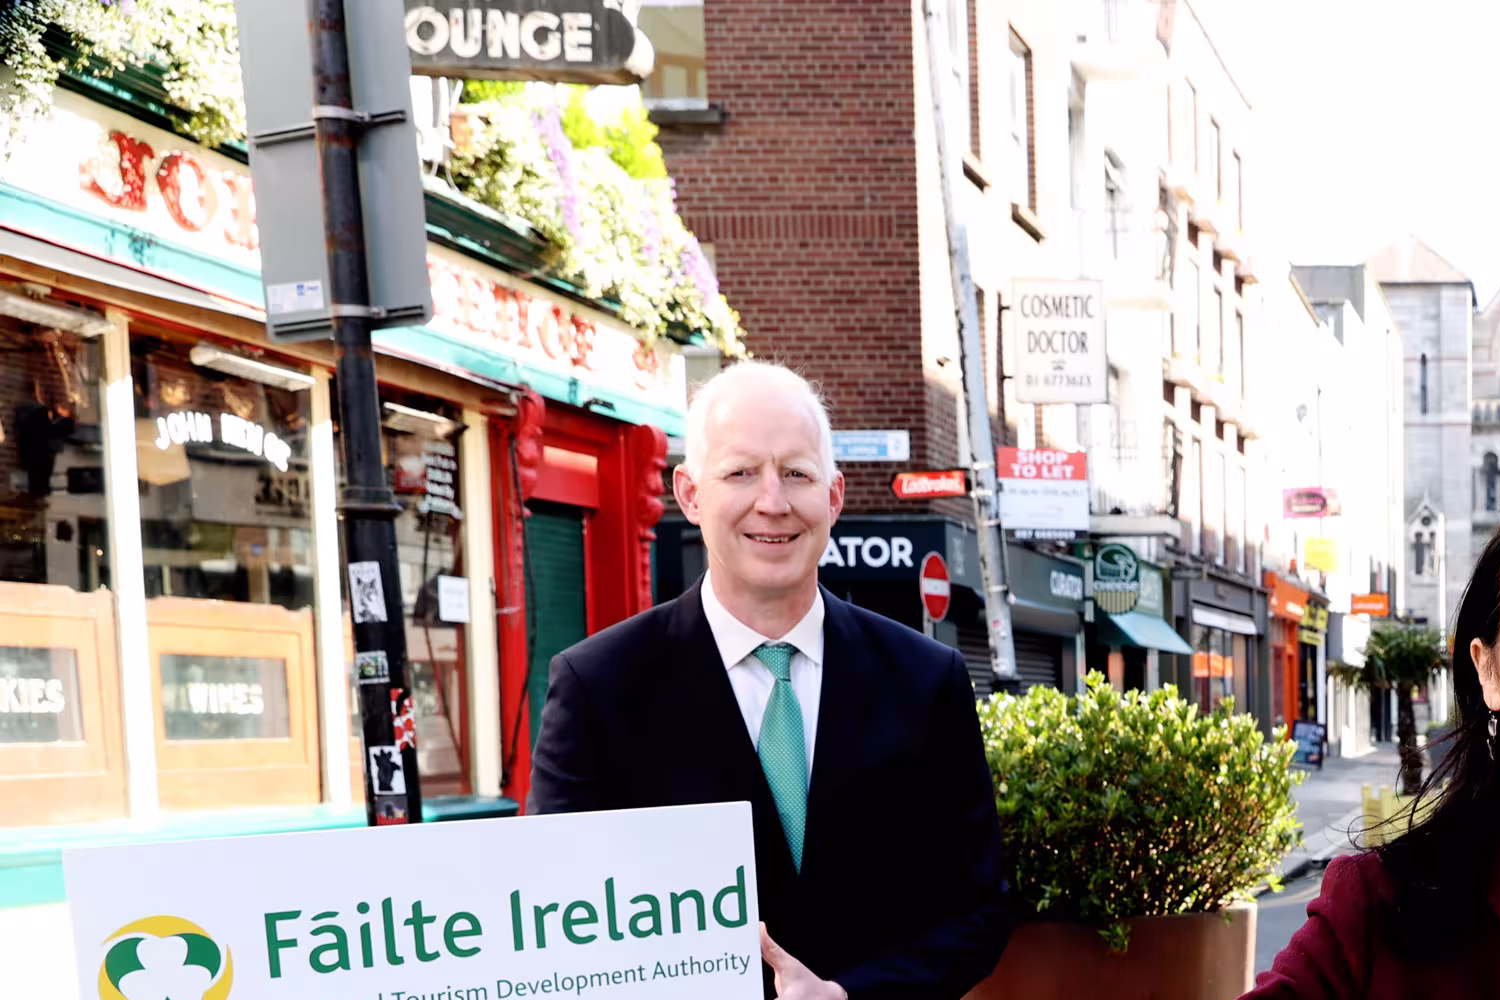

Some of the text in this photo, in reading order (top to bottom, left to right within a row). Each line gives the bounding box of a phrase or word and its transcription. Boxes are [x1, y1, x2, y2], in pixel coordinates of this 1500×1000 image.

[403, 5, 594, 63] OUNGE
[1020, 294, 1095, 319] COSMETIC
[1027, 330, 1089, 354] DOCTOR
[156, 411, 213, 450] JOHN
[1010, 464, 1075, 480] TO LET
[1017, 449, 1069, 465] SHOP
[817, 536, 914, 568] ATOR
[187, 682, 264, 714] WINES
[510, 865, 749, 952] Ireland
[496, 964, 647, 1000] Development
[652, 952, 751, 981] Authority
